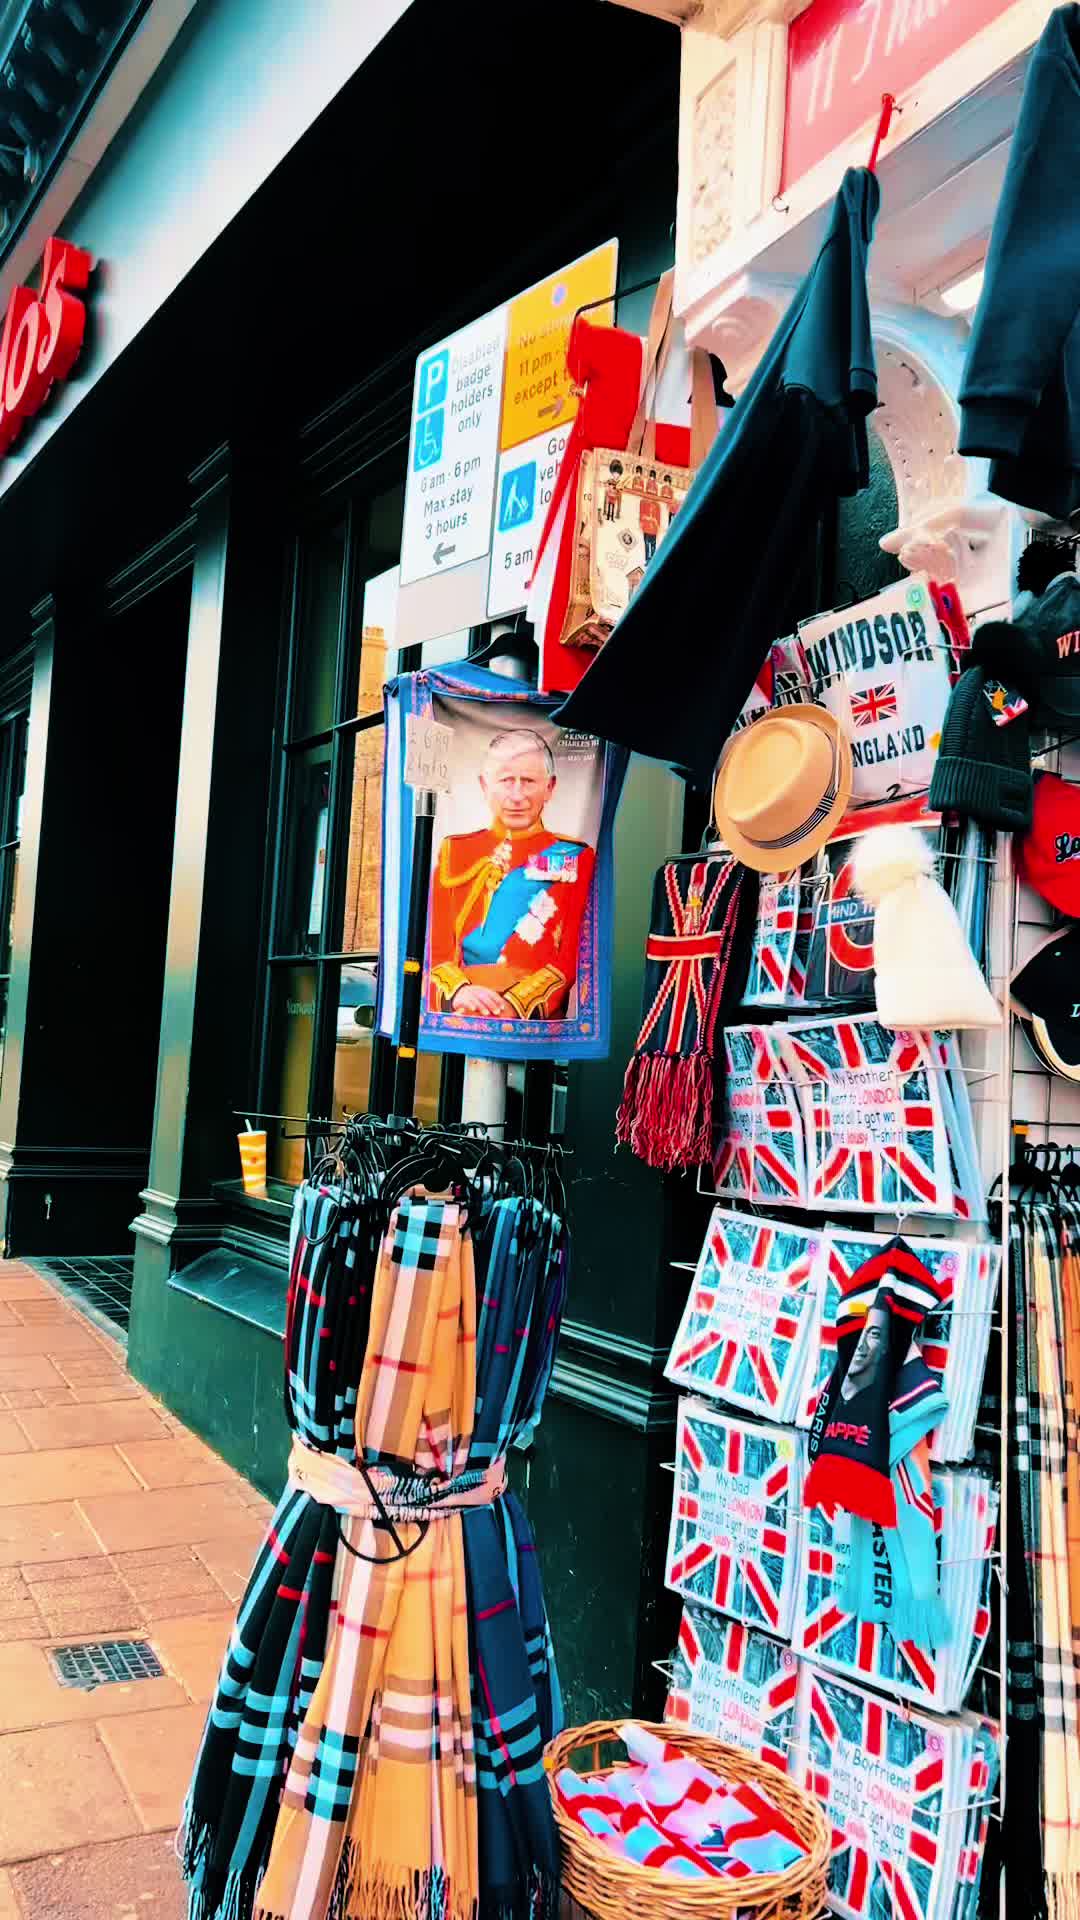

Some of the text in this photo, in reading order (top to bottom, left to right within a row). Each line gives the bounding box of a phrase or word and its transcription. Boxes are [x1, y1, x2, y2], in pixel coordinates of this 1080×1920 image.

[531, 351, 552, 374] pm
[425, 360, 446, 409] P
[456, 363, 491, 392] badge
[513, 369, 557, 405] except
[450, 383, 494, 416] holders
[457, 408, 482, 433] only
[547, 437, 566, 456] Go
[463, 456, 481, 477] pm
[423, 485, 473, 518] Max stay
[425, 511, 468, 541] 3 hours
[504, 548, 533, 571] 5 am
[805, 611, 934, 695] WINDSOR
[1056, 630, 1080, 659] WI
[851, 724, 925, 768] NGLAND
[846, 1069, 895, 1085] Brother
[864, 1111, 880, 1129] got
[745, 1269, 777, 1288] Sister
[811, 1391, 830, 1453] PARIS
[731, 1476, 751, 1496] Dad
[714, 1671, 761, 1712] Girlfriend
[852, 1747, 911, 1793] Boyfriend
